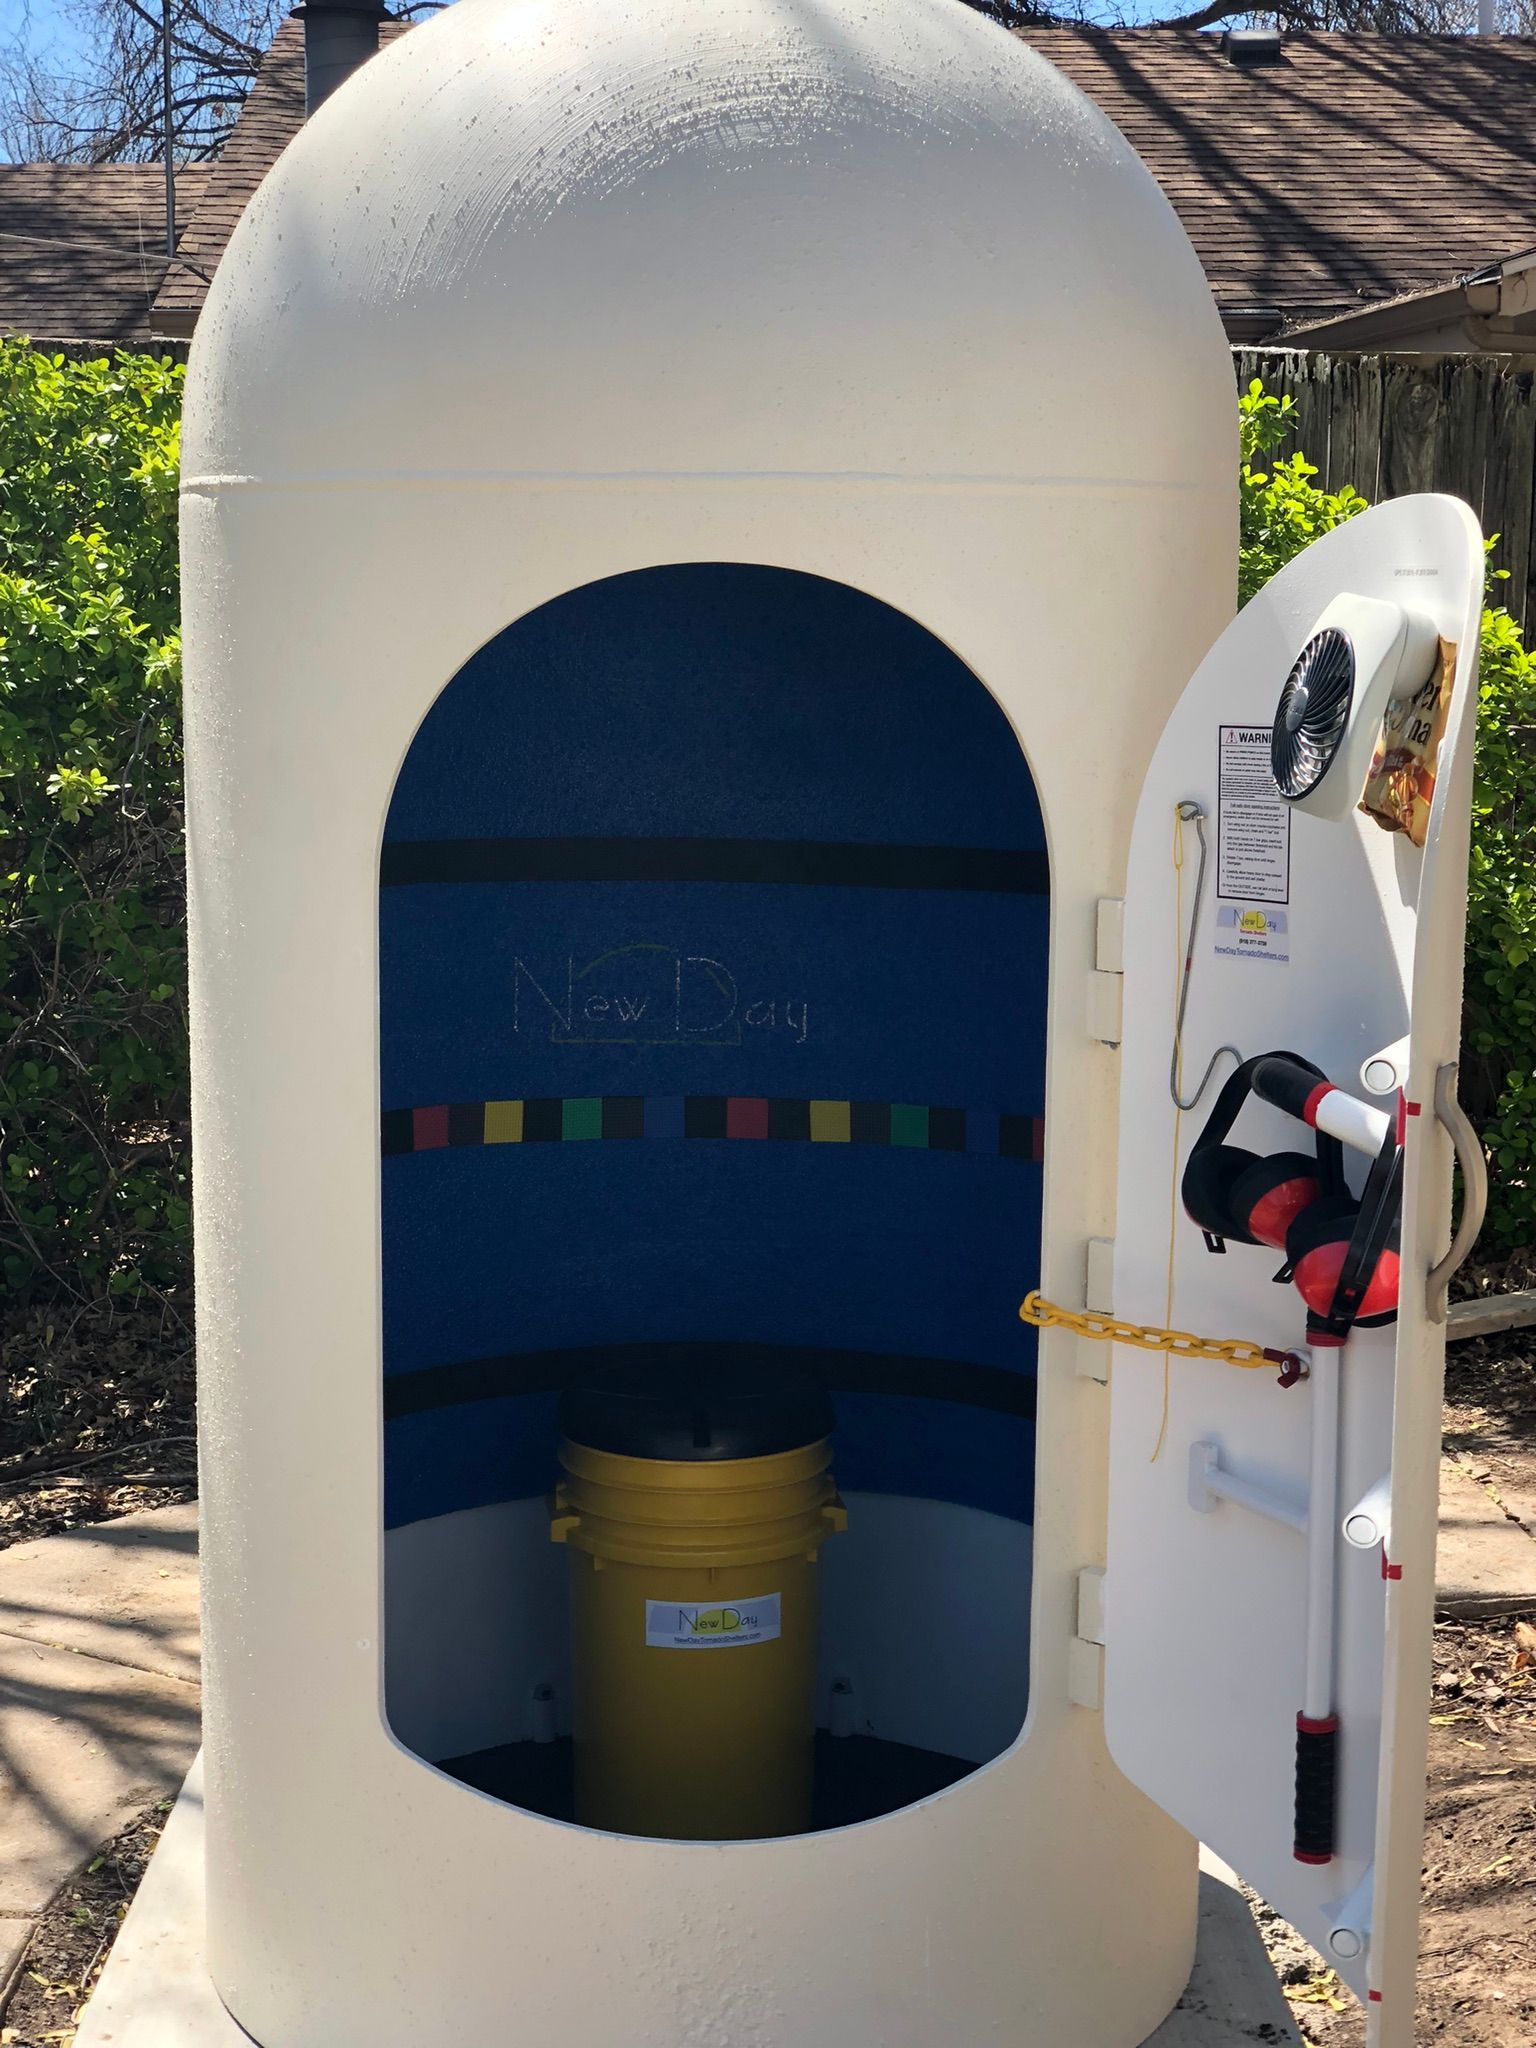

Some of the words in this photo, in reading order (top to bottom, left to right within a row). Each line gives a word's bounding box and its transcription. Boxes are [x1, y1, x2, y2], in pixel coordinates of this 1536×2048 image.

[1239, 732, 1272, 744] WARNI
[513, 955, 650, 1032] New
[675, 957, 808, 1045] Day
[679, 1608, 719, 1631] New
[722, 1607, 758, 1630] Day
